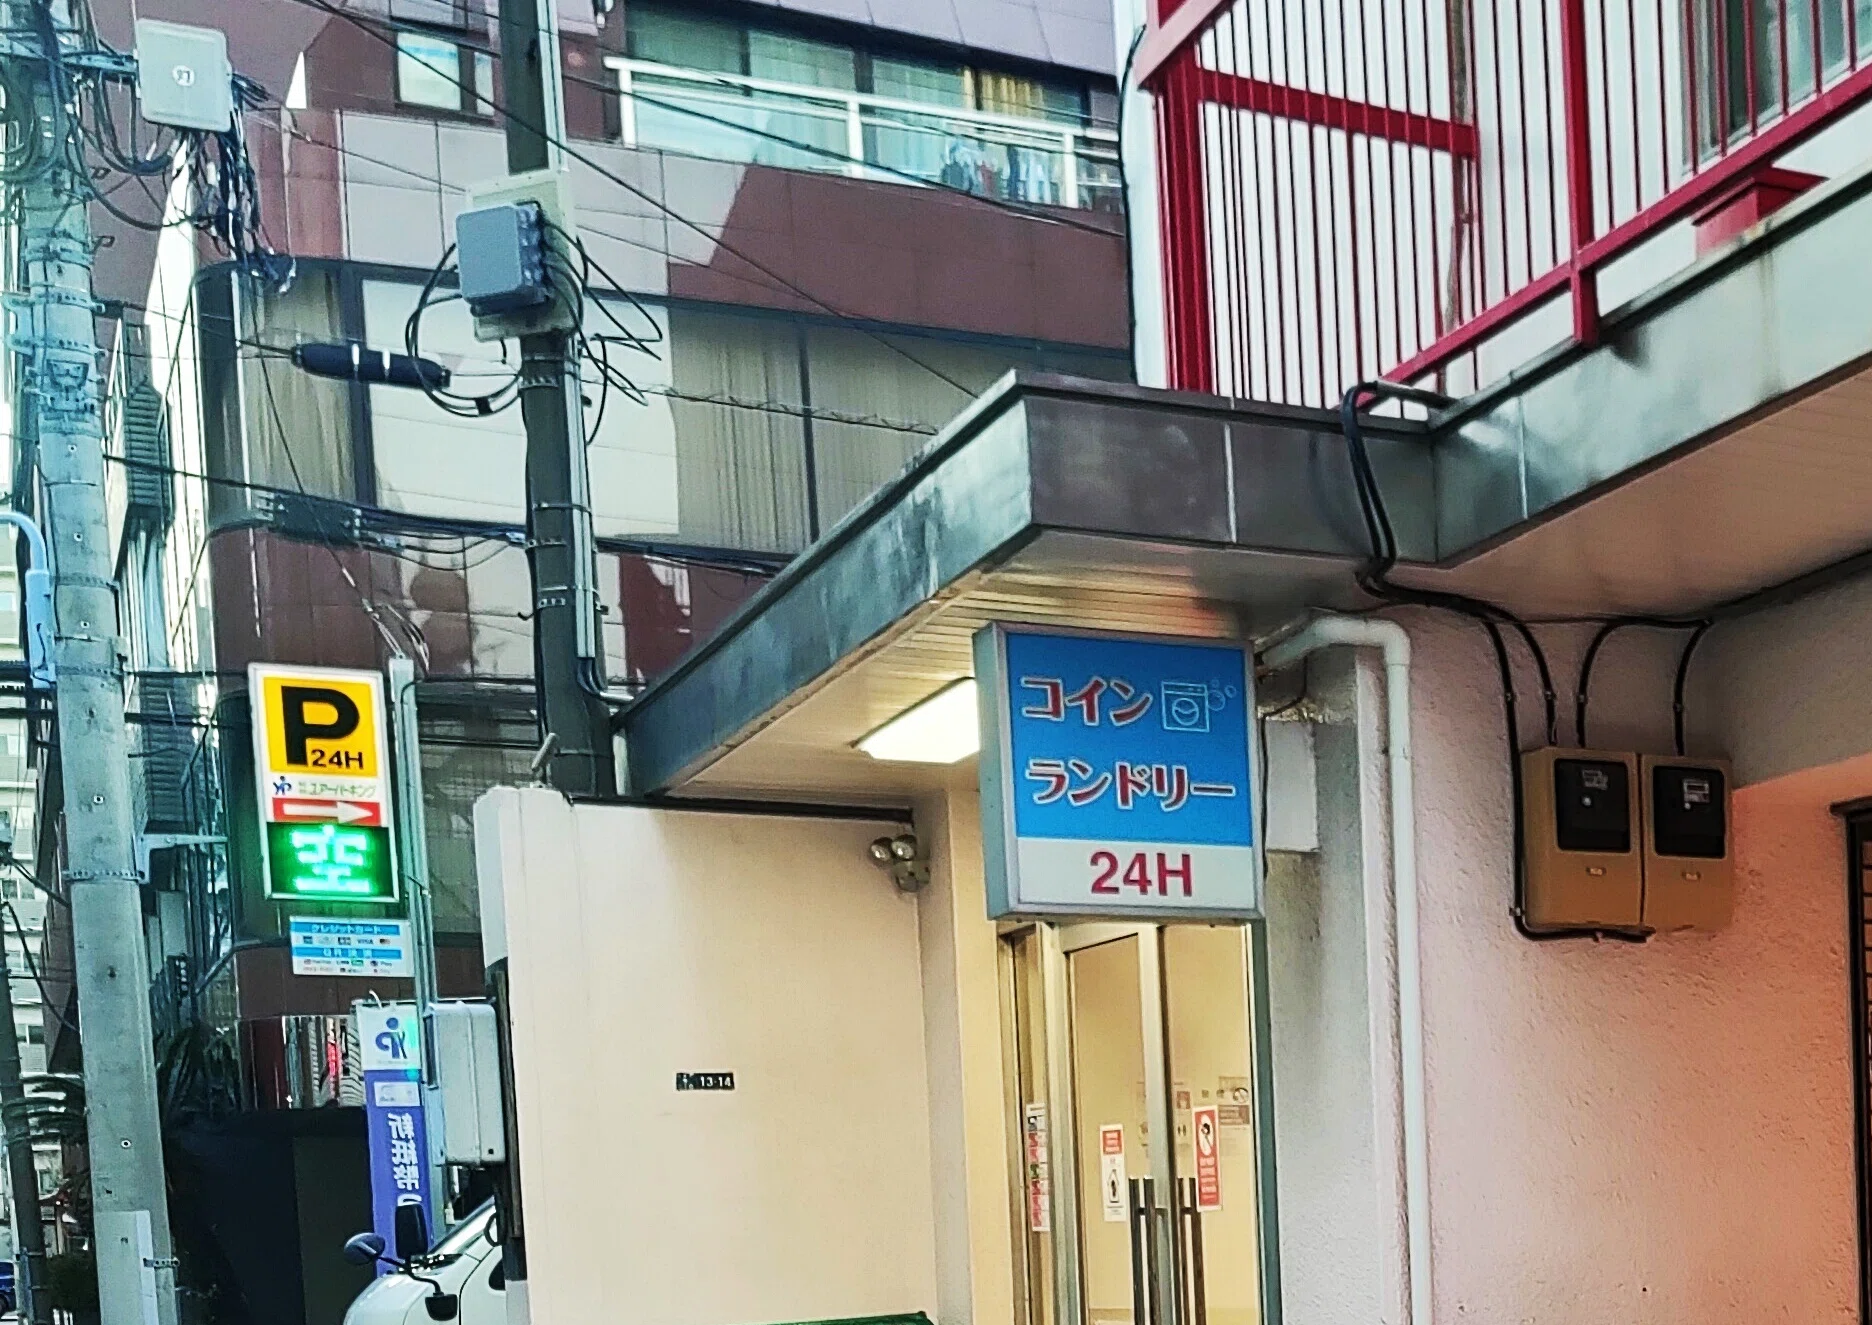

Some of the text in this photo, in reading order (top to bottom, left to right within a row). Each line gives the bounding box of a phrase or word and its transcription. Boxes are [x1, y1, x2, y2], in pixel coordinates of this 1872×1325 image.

[280, 684, 361, 767] P
[1020, 675, 1153, 727] コイン
[311, 748, 364, 770] 24H
[1025, 756, 1236, 812] ランドリー
[291, 824, 372, 893] 空
[1090, 851, 1193, 898] 24H
